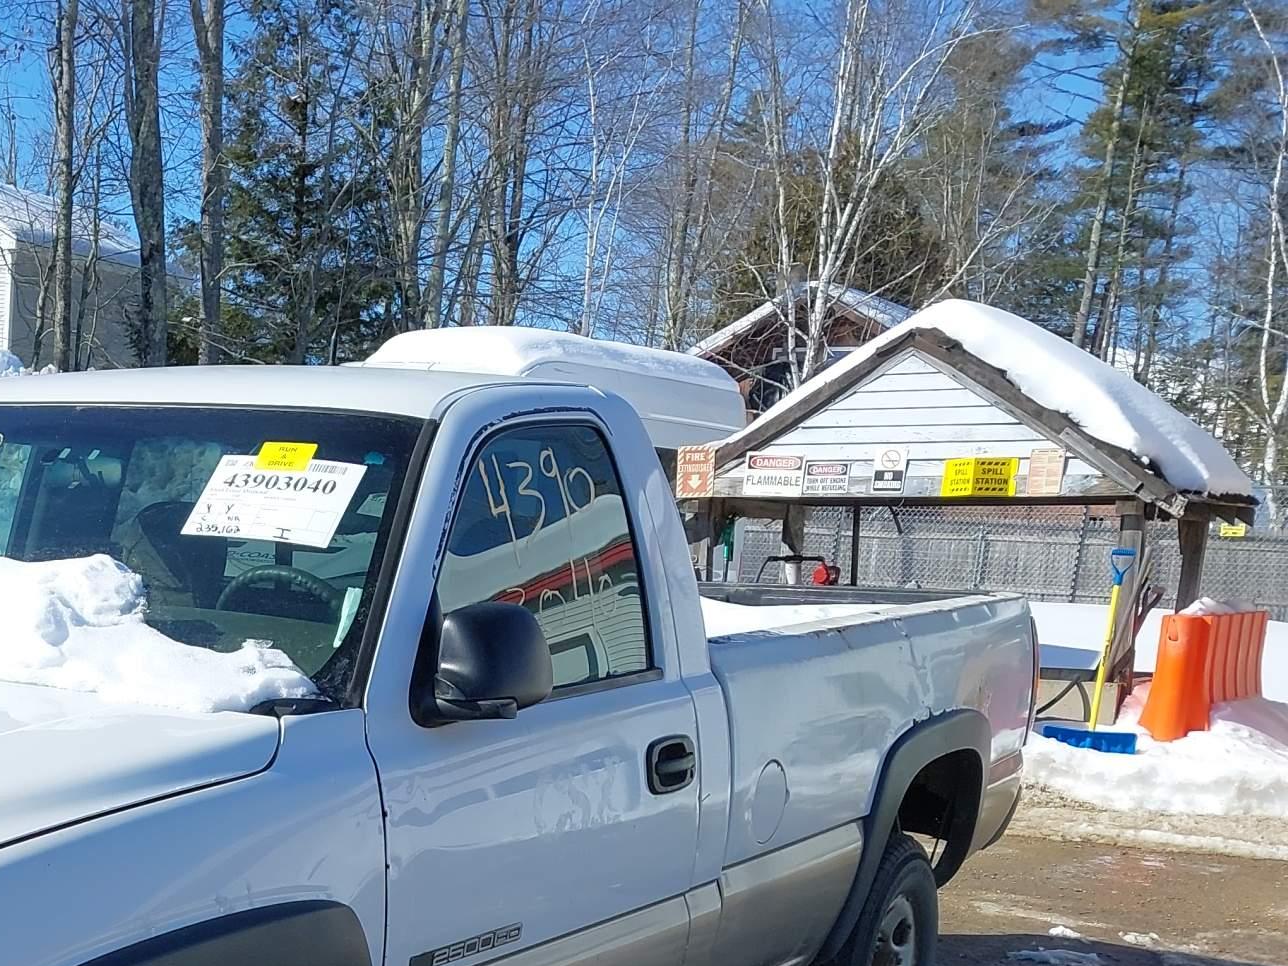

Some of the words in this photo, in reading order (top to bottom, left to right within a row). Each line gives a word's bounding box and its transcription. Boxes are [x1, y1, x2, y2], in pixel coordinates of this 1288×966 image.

[685, 452, 705, 461] FIRE
[756, 457, 796, 467] DANGER
[813, 465, 842, 474] DANGER
[954, 468, 968, 476] SPILL
[981, 467, 1004, 476] SPILL
[223, 472, 337, 495] 43903040
[746, 474, 801, 487] FLAMMABLE
[950, 478, 970, 486] STATION
[975, 477, 1008, 486] STATION
[478, 447, 596, 567] 4390
